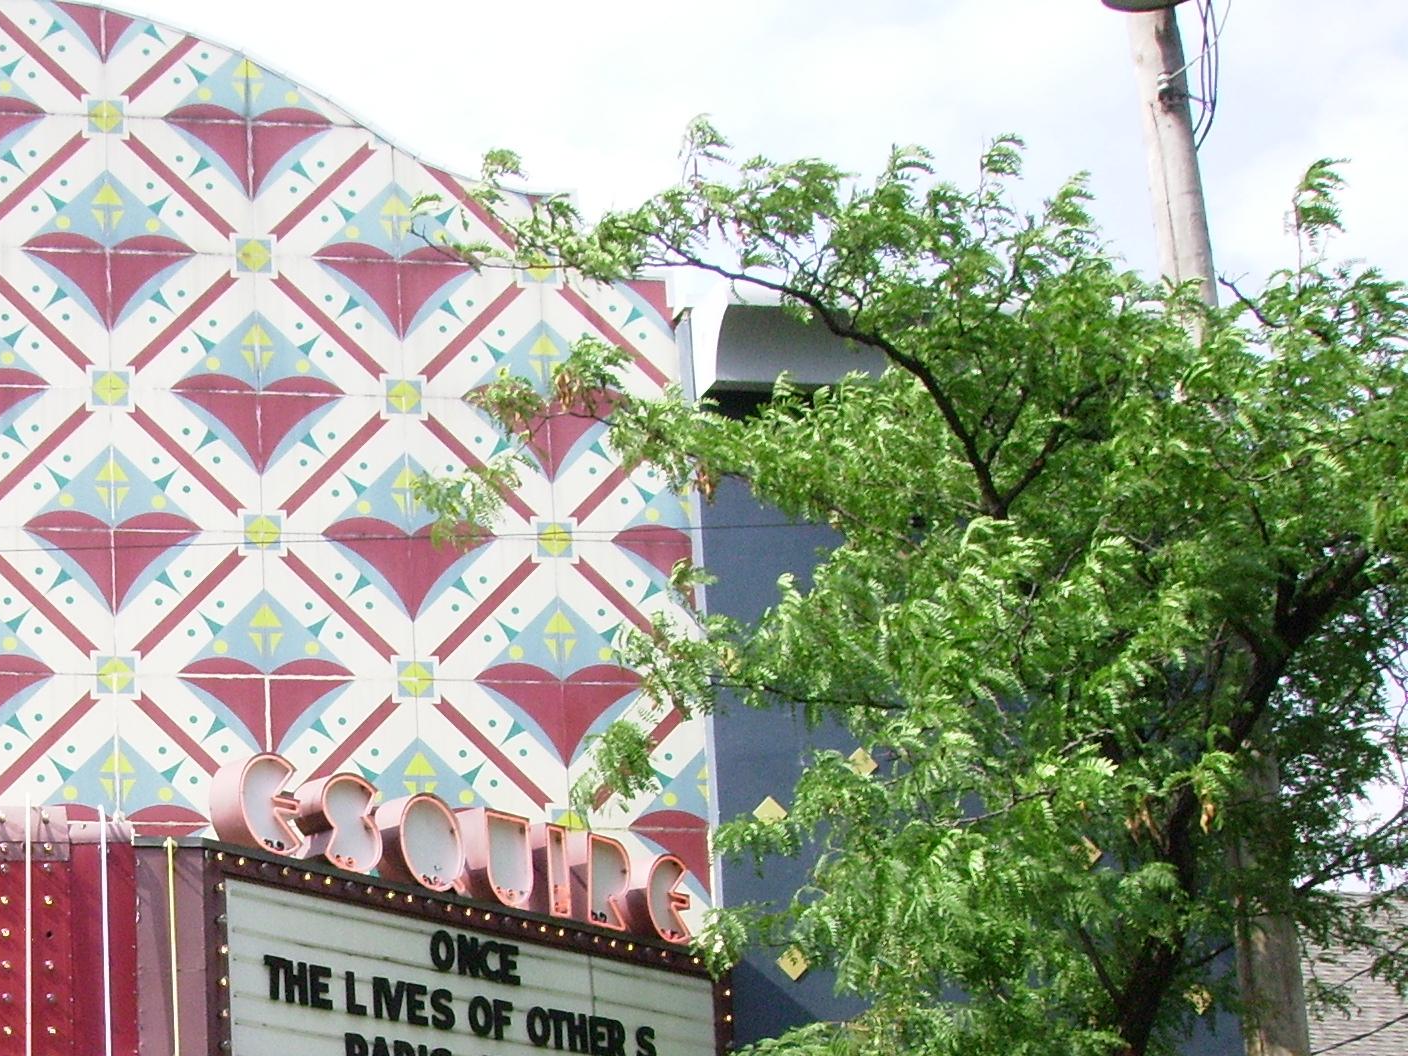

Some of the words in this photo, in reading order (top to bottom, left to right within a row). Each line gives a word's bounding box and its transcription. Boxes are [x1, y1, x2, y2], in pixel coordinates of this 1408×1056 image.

[212, 752, 692, 943] ESQUIRE
[264, 955, 334, 1010] THE
[346, 971, 456, 1031] LIVES
[468, 995, 513, 1041] OF
[430, 930, 522, 986] ONCE
